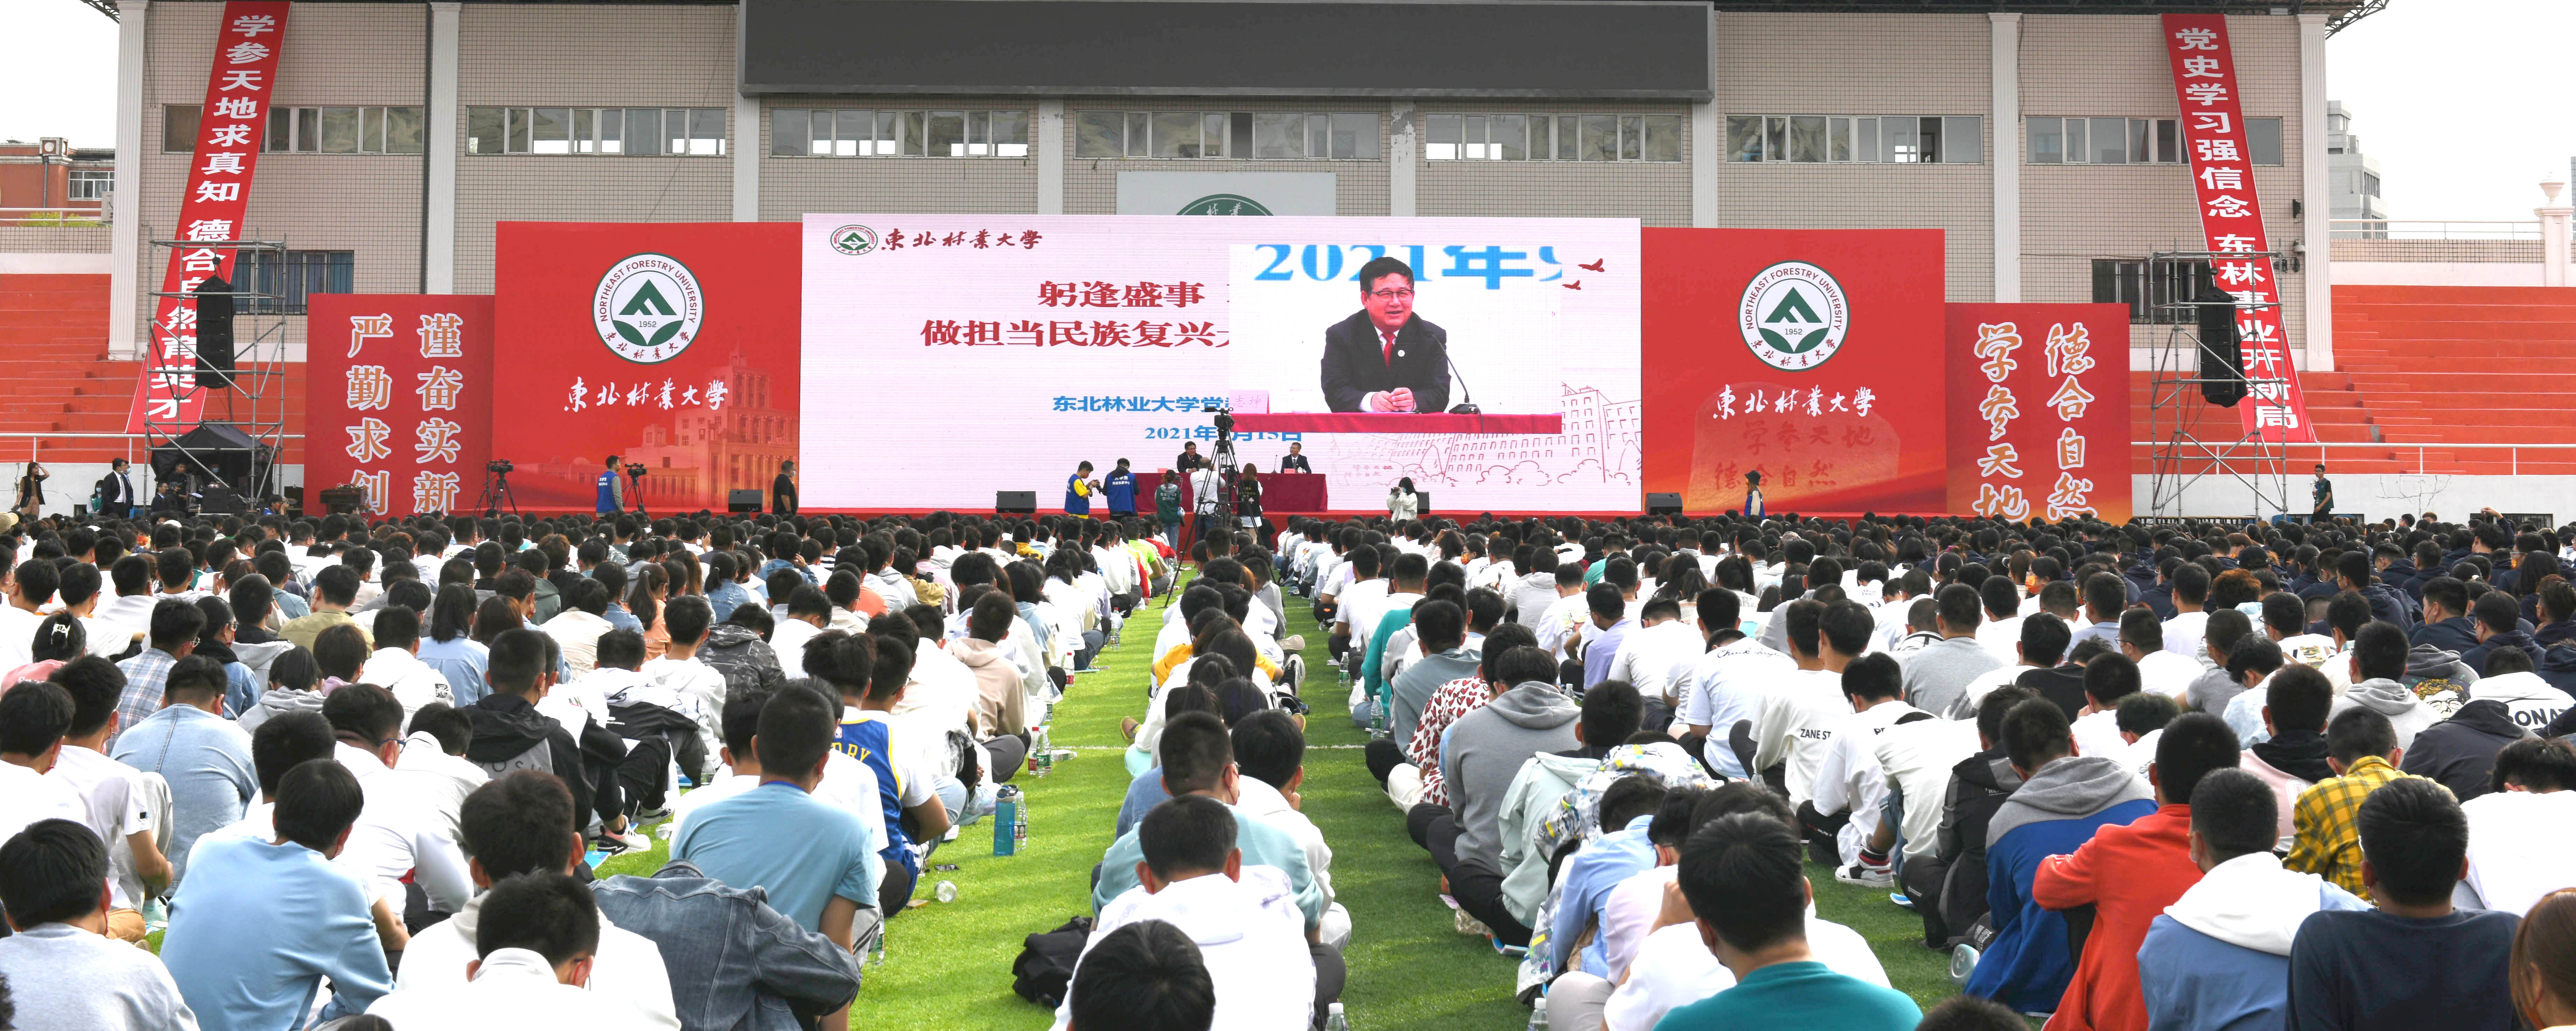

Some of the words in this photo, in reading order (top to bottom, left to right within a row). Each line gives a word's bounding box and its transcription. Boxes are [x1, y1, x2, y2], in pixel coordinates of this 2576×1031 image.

[195, 15, 274, 203] 学参天地求真知
[2176, 28, 2252, 218] 党史学习强信念
[600, 269, 624, 322] NORTHEAST
[626, 260, 675, 272] FORESTRY
[675, 270, 697, 323] UNIVERSITY
[1038, 281, 1205, 308] 躬逢盛事
[1745, 277, 1769, 330] NORTHEAST
[1770, 268, 1819, 280] FORESTRY
[1819, 278, 1842, 330] UNIVERSITY
[1053, 396, 1229, 412] 东北林业大学党
[1144, 425, 1301, 441] 2021年月15日
[2044, 322, 2098, 521] 德合自然
[1800, 729, 1820, 739] ZANE
